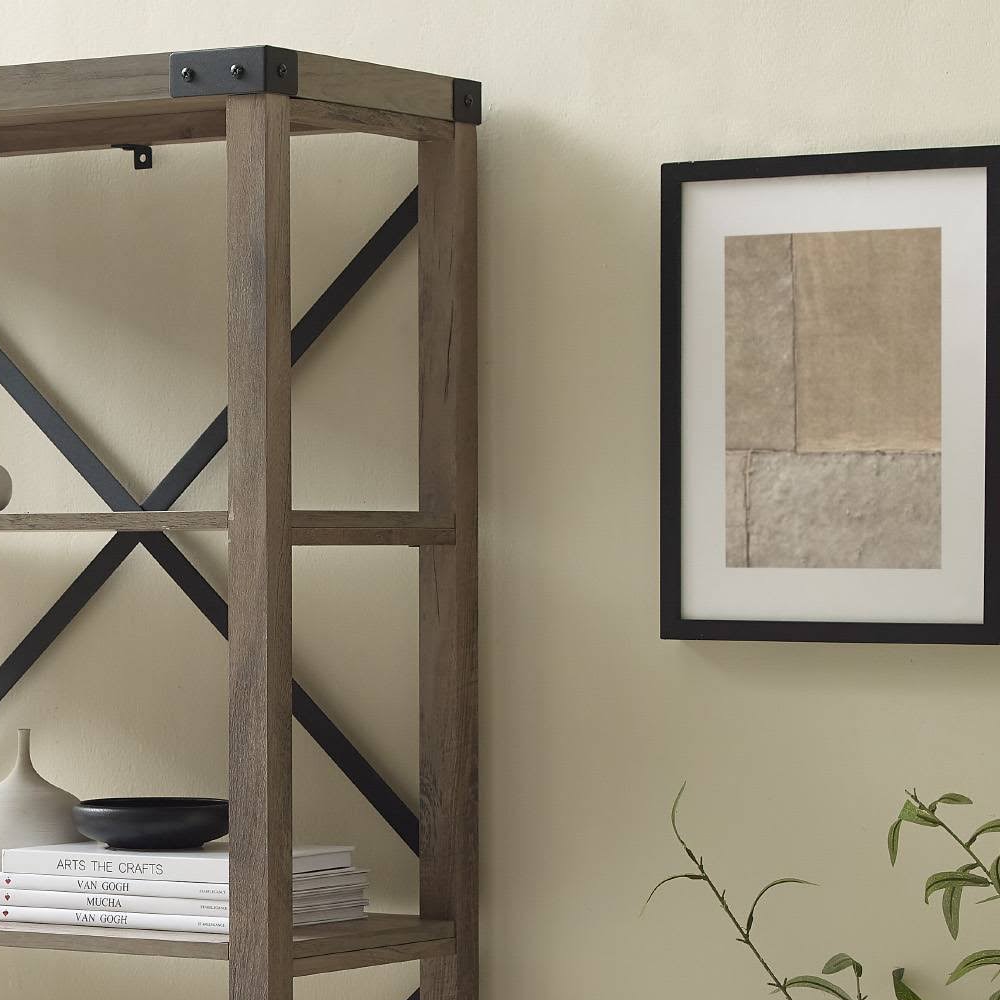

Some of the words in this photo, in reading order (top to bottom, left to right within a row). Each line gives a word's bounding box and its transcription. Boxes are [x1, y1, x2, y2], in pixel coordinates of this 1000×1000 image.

[56, 859, 86, 871] ARTS
[91, 860, 113, 873] THE
[118, 862, 163, 875] CRAFTS
[77, 880, 97, 890] VAN
[101, 881, 129, 892] GOGH
[86, 897, 122, 908] MUCHA
[75, 912, 96, 922] VAN
[100, 914, 128, 925] GOGH
